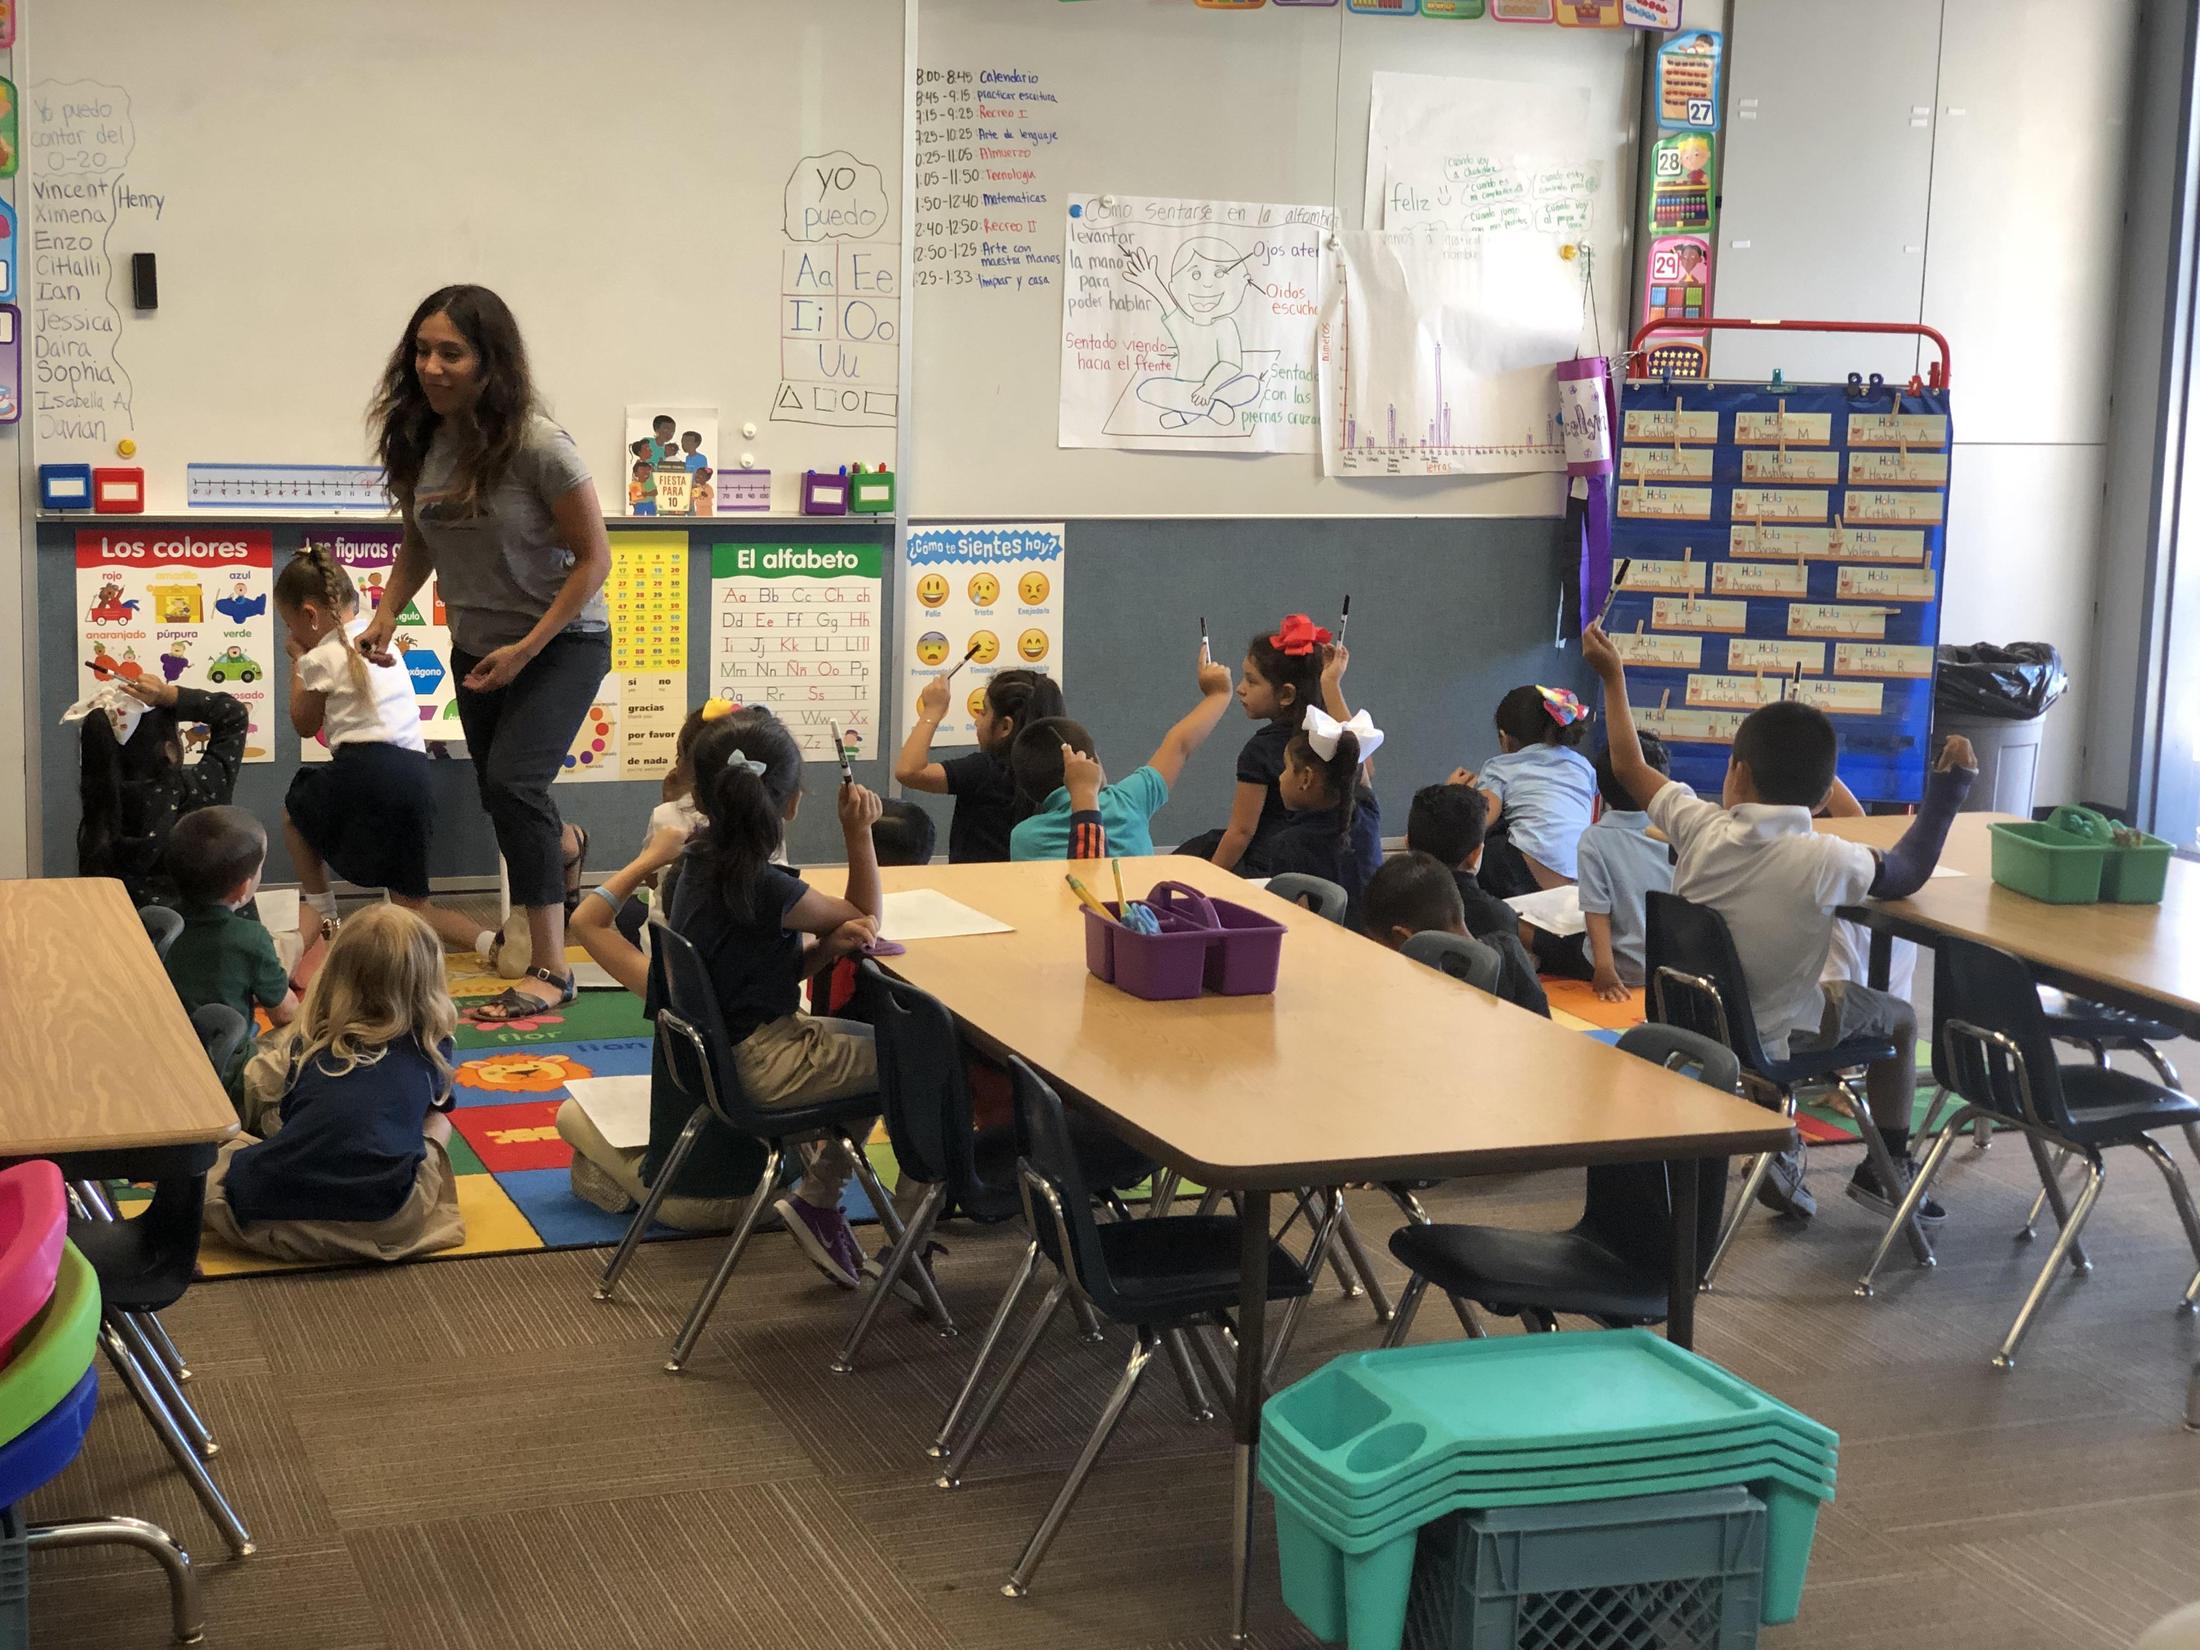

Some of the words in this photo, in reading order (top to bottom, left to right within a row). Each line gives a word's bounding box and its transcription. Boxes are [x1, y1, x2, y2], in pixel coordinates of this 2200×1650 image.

[980, 69, 1038, 83] Calendario
[62, 102, 112, 126] puedo
[980, 105, 1014, 118] Recreo
[1690, 102, 1711, 121] 27
[31, 128, 85, 148] contar
[96, 126, 124, 145] del
[979, 128, 998, 140] Arte
[1004, 129, 1013, 139] de
[1020, 129, 1058, 146] lenguaje
[980, 147, 1031, 159] Almuerzo
[1660, 152, 1680, 170] 28
[33, 180, 109, 200] Vincent
[1390, 183, 1430, 211] feliz
[118, 184, 164, 220] Henry
[34, 206, 107, 224] Ximena
[805, 199, 877, 238] puedo
[1146, 203, 1212, 221] Sentarse
[1228, 206, 1245, 220] en
[1258, 205, 1271, 225] la
[983, 218, 1022, 233] Recreo
[34, 231, 93, 251] Enzo
[1071, 228, 1134, 244] levantar
[983, 243, 1007, 255] Arte
[1013, 245, 1031, 253] con
[1253, 240, 1285, 266] Ojos
[1070, 251, 1083, 269] la
[1089, 256, 1124, 270] mano
[1656, 256, 1676, 274] 29
[796, 253, 833, 288] Aa
[853, 254, 893, 294] Ee
[36, 282, 80, 301] Ian
[1017, 277, 1022, 291] y
[1028, 276, 1049, 285] casa
[1079, 277, 1109, 291] para
[1068, 297, 1102, 316] poder
[1109, 290, 1153, 311] hablar
[36, 308, 112, 332] Jessica
[789, 301, 823, 331] Ii
[845, 301, 894, 340] Oo
[35, 336, 91, 358] Daira
[1066, 333, 1116, 349] Sentado
[1126, 338, 1167, 352] viendo
[820, 344, 860, 377] Uu
[1078, 353, 1110, 370] hacia
[1117, 355, 1130, 370] el
[1136, 353, 1172, 372] frente
[37, 361, 114, 391] Sophia
[36, 392, 103, 411] Isabella
[1265, 389, 1286, 400] con
[1294, 386, 1311, 403] las
[1242, 412, 1282, 431] piernas
[1654, 414, 1673, 424] Hola
[659, 476, 686, 485] FIESTA
[663, 487, 683, 496] PARA
[1647, 490, 1666, 500] Hola
[1762, 493, 1782, 503] Hola
[668, 497, 678, 507] 10
[1788, 505, 1799, 516] M
[1856, 532, 1876, 543] Hola
[102, 537, 145, 558] Los
[153, 536, 248, 558] colores
[335, 537, 388, 563] figuras
[946, 543, 956, 555] te
[958, 538, 1021, 557] sientes
[1025, 538, 1057, 555] hoy?
[737, 549, 754, 568] El
[763, 549, 858, 568] alfabeto
[103, 572, 122, 582] rojo
[229, 571, 251, 579] azul
[1742, 567, 1761, 577] Hola
[1868, 571, 1888, 582] Hola
[724, 588, 746, 602] Aa
[760, 588, 779, 602] Bb
[792, 588, 811, 602] Cc
[825, 588, 844, 602] Ch
[856, 588, 870, 602] ch
[1819, 608, 1839, 618] Hola
[723, 613, 743, 627] Dd
[756, 613, 774, 627] Ee
[787, 613, 803, 627] Ff
[817, 613, 838, 633] Gg
[850, 613, 869, 627] Hh
[86, 631, 146, 641] anaranjado
[157, 629, 198, 641] púrpura
[224, 630, 252, 638] verde
[724, 638, 733, 651] Ii
[750, 638, 765, 658] Jj
[781, 638, 799, 651] Kk
[409, 666, 441, 678] xágono
[721, 663, 746, 677] Mm
[757, 663, 776, 676] Nn
[787, 661, 807, 676] Ññ
[818, 662, 839, 676] Oo
[850, 662, 869, 681] Pp
[233, 691, 264, 700] osado
[767, 687, 785, 700] Rr
[808, 686, 824, 700] Ss
[851, 686, 867, 700] Tt
[628, 704, 664, 713] gracias
[801, 711, 830, 725] Ww
[849, 710, 868, 724] Xx
[628, 732, 645, 740] por
[803, 735, 820, 749] Zz
[497, 1030, 562, 1042] flor
